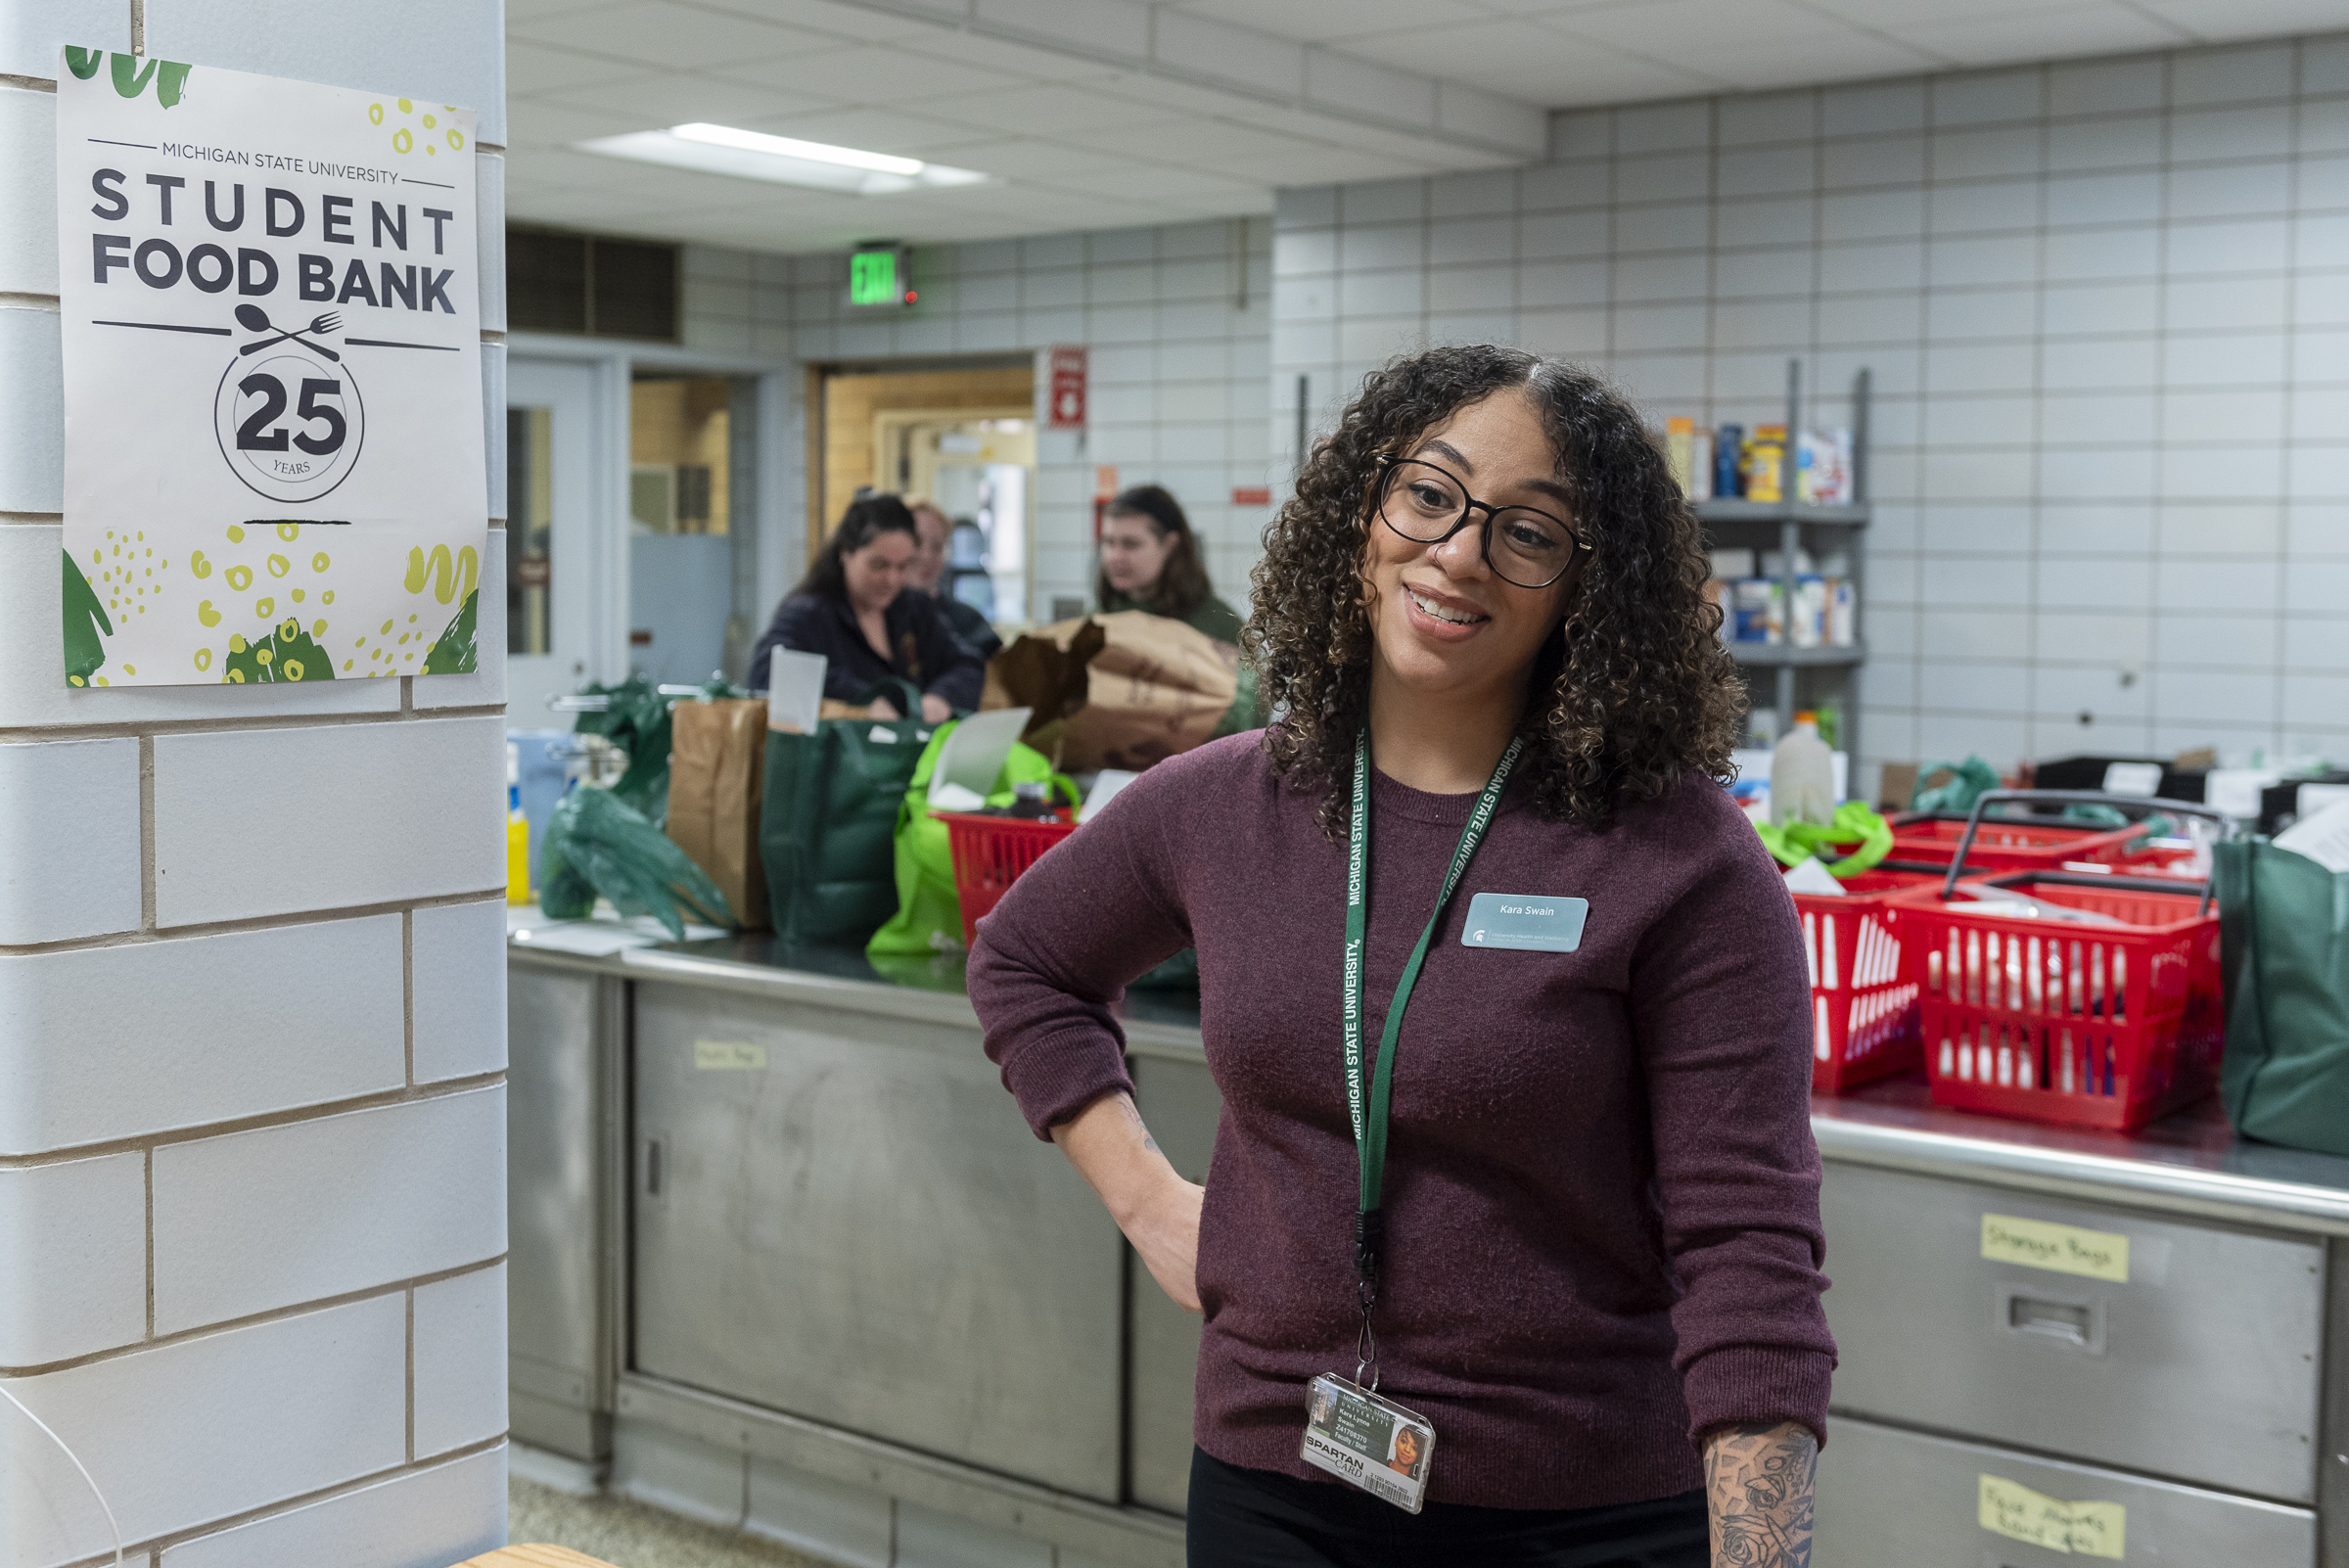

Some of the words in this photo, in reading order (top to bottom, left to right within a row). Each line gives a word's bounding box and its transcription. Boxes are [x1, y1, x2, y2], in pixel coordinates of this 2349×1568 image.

[162, 142, 250, 166] MICHIGAN
[254, 153, 303, 173] STATE
[308, 161, 398, 185] UNIVERSITY
[91, 167, 453, 255] STUDENT
[92, 233, 279, 297] FOOD
[299, 253, 457, 315] BANK
[237, 373, 347, 456] 25
[273, 459, 311, 475] YEARS
[1488, 736, 1524, 793] MICHIGAN
[1352, 803, 1363, 843] STATE
[1471, 793, 1497, 832] STATE
[1350, 843, 1361, 906] MICHIGAN
[1499, 904, 1523, 915] Kara
[1525, 905, 1554, 916] Swain
[1345, 1022, 1359, 1066] STATE
[1347, 1068, 1361, 1140] MICHIGAN
[1337, 1415, 1355, 1428] Swain
[1339, 1407, 1353, 1419] Kara
[1341, 1402, 1389, 1427] UNIVERSITY
[1374, 1409, 1390, 1420] STATE
[1306, 1435, 1364, 1471] SPARTAN
[1334, 1431, 1352, 1445] Faculty
[1355, 1441, 1367, 1452] Staff
[1334, 1459, 1362, 1478] CARD
